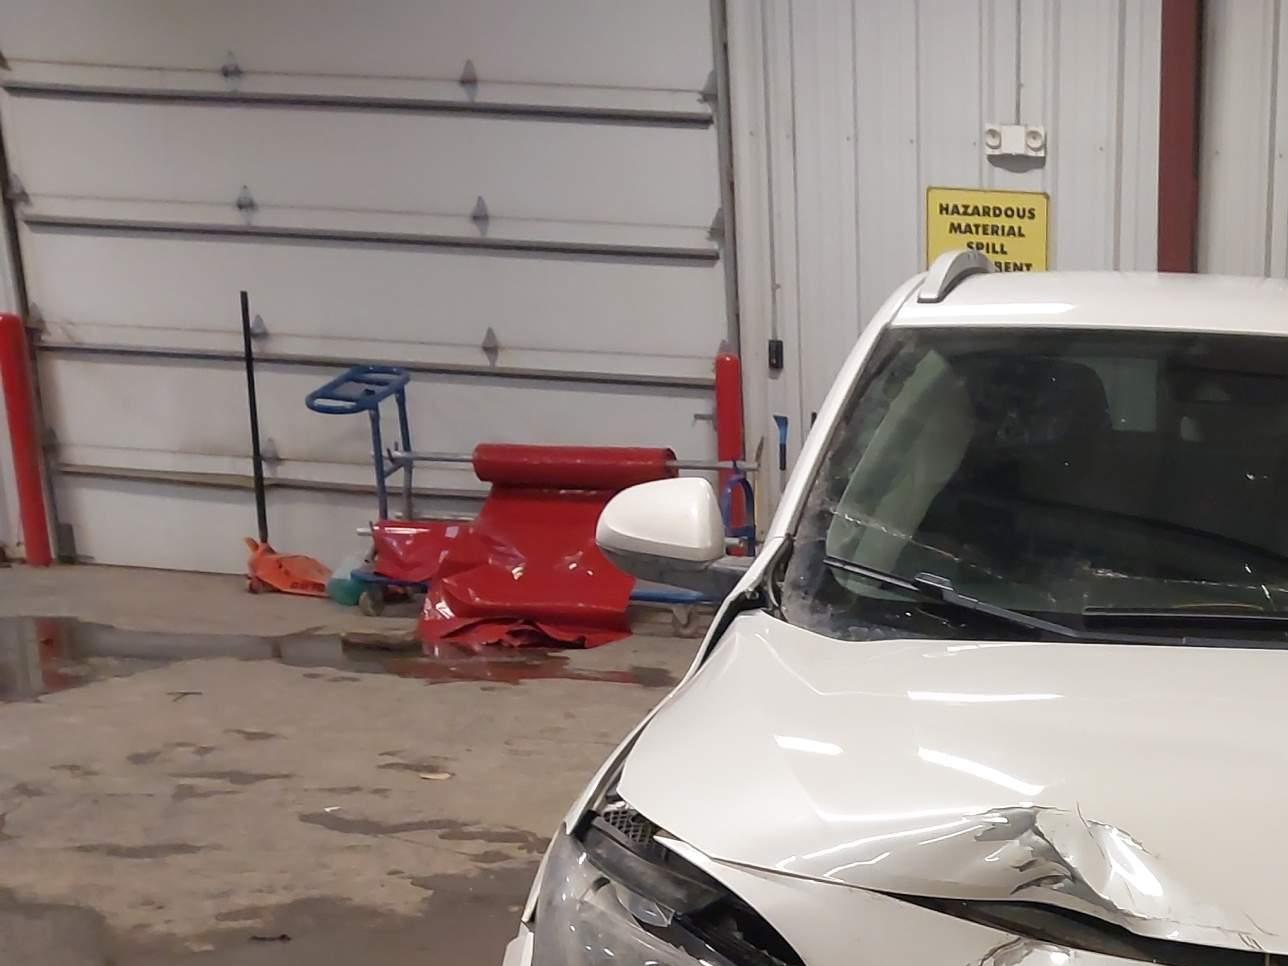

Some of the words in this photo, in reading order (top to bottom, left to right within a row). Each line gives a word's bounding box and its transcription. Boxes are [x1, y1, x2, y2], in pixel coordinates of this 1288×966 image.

[939, 203, 1036, 220] HAZARDOUS
[948, 222, 1026, 238] MATERIAL
[966, 241, 1008, 255] SPILL
